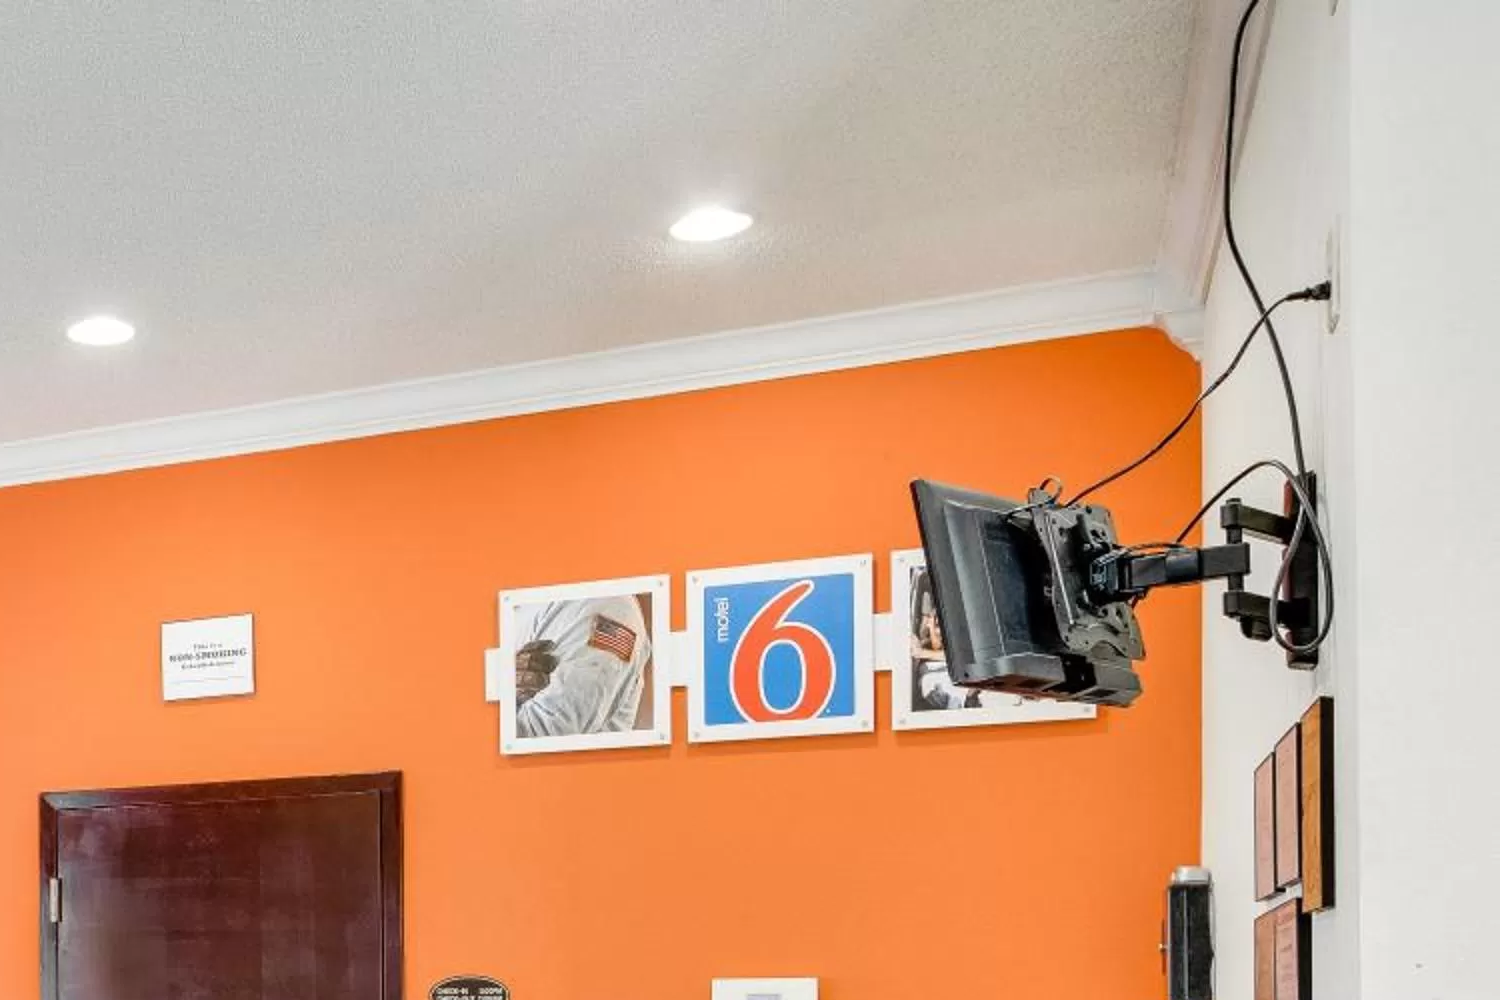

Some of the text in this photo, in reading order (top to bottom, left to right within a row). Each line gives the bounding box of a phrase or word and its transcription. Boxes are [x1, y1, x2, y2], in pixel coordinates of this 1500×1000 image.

[169, 647, 247, 662] NON-SMOKING
[714, 579, 836, 723] motel 6
